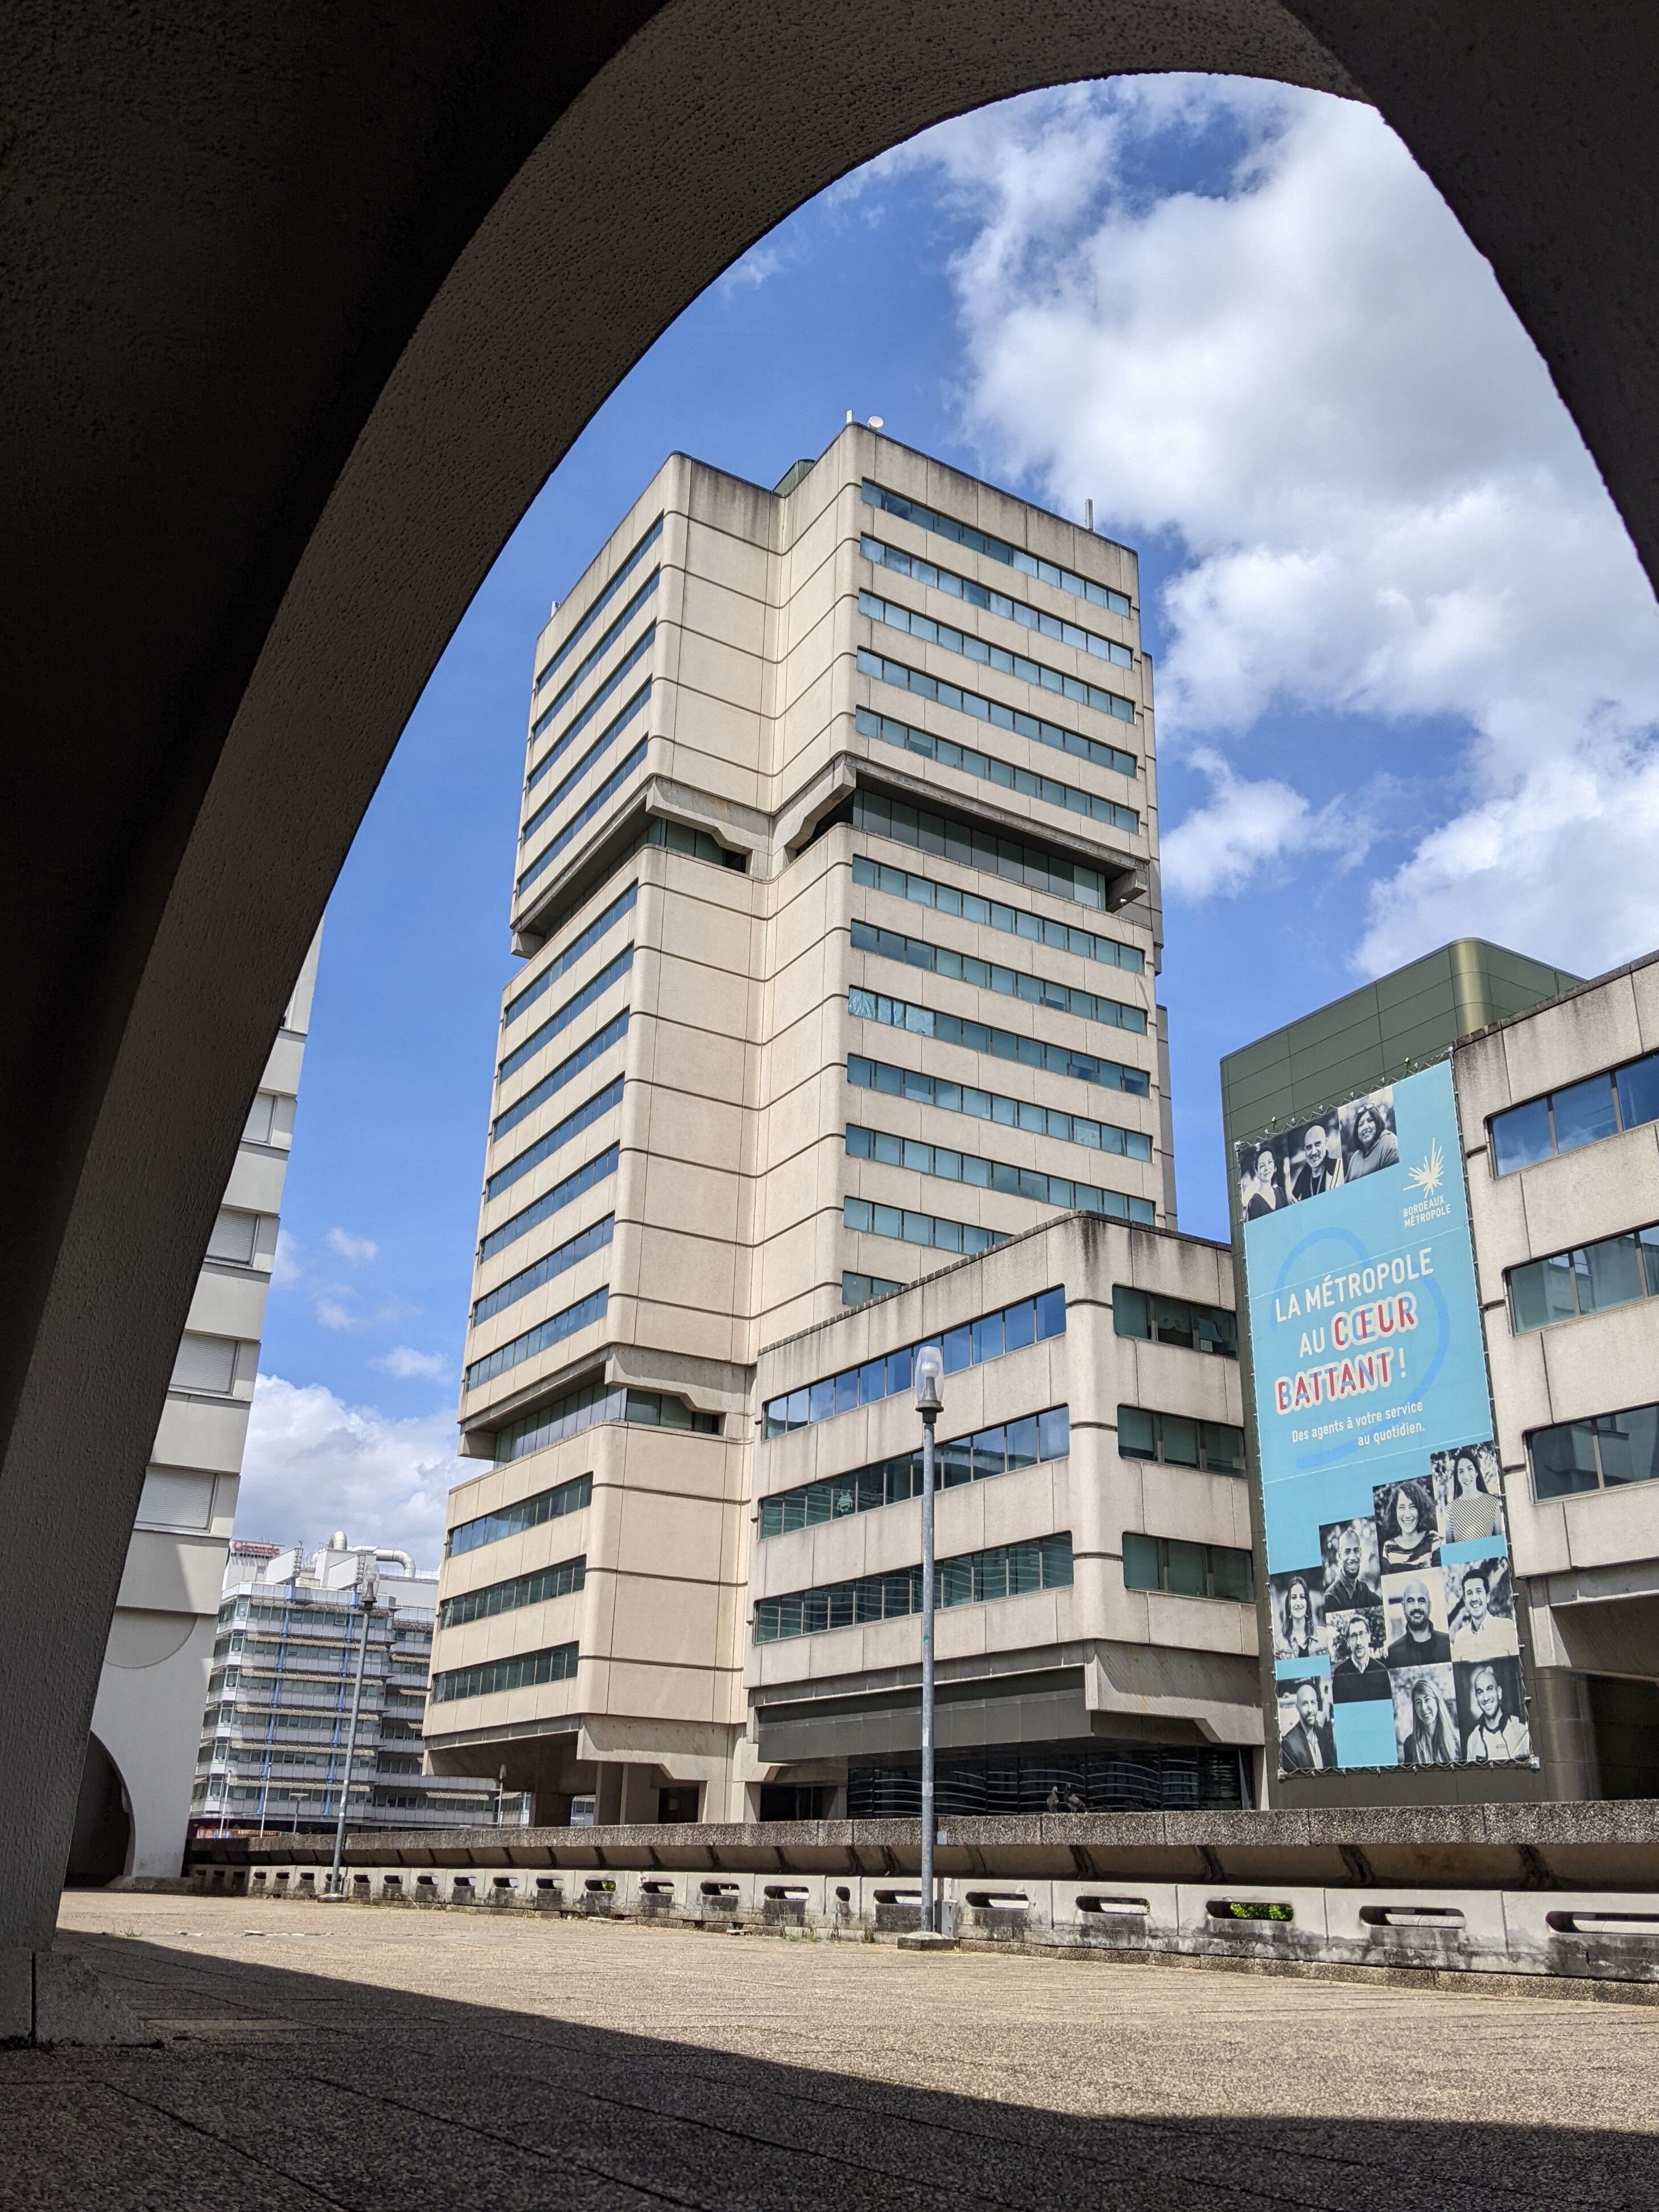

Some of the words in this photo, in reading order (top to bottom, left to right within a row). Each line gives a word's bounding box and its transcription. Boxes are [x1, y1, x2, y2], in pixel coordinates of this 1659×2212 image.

[1403, 1195, 1444, 1218] BORDEAUX
[1404, 1204, 1451, 1228] MÉTROPOLE
[1275, 1293, 1301, 1322] LA
[1305, 1247, 1434, 1313] MÉTROPOLE
[1300, 1327, 1325, 1358] AU
[1332, 1293, 1417, 1349] CŒUR
[1276, 1348, 1393, 1413] BATTANT
[1292, 1430, 1309, 1443] Des
[1312, 1421, 1344, 1439] agents
[1347, 1417, 1354, 1429] à
[1355, 1410, 1382, 1426] votre
[1385, 1401, 1423, 1420] service
[1358, 1435, 1370, 1446] au
[1374, 1422, 1425, 1445] quotidien.
